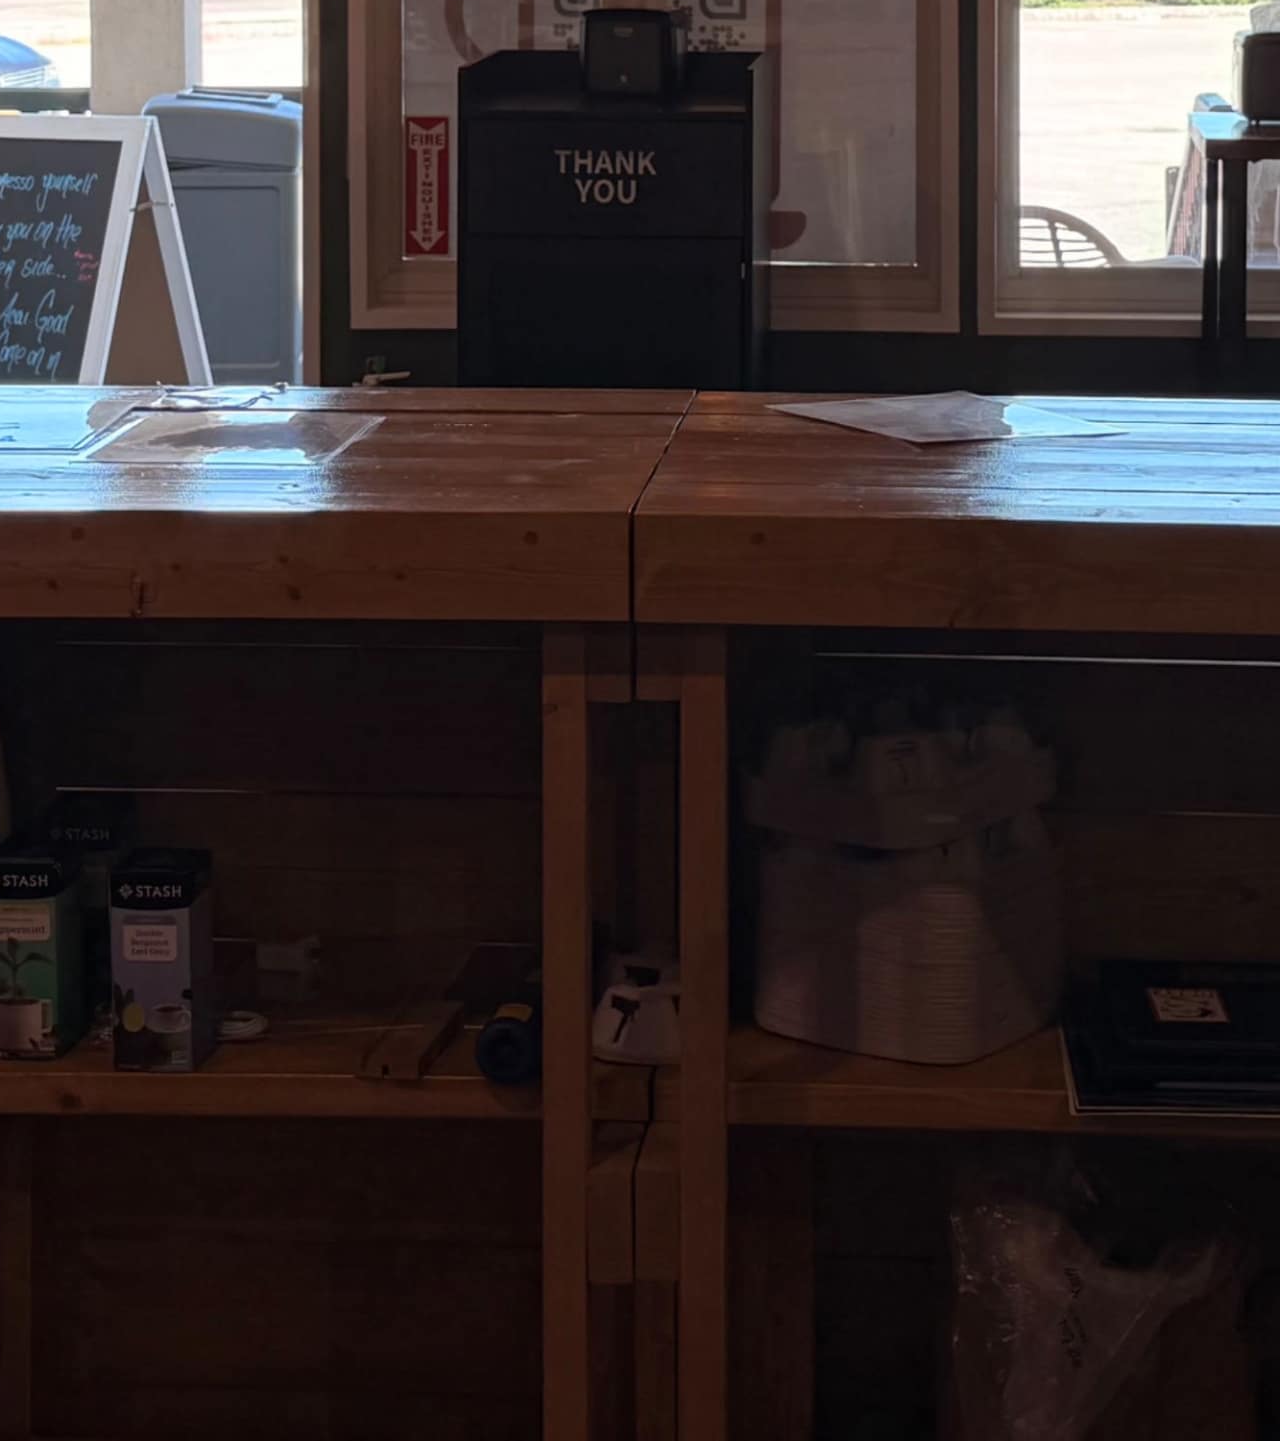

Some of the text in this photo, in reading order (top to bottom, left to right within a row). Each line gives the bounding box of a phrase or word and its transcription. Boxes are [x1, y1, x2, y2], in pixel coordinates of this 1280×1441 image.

[410, 134, 444, 146] FIRE
[554, 149, 657, 176] THANK
[35, 172, 99, 213] yourself
[421, 148, 433, 243] EXTINGUISHER
[575, 179, 638, 205] YOU
[55, 212, 82, 248] the
[64, 827, 111, 842] STASH
[2, 873, 50, 888] STASH
[134, 885, 183, 899] STASH
